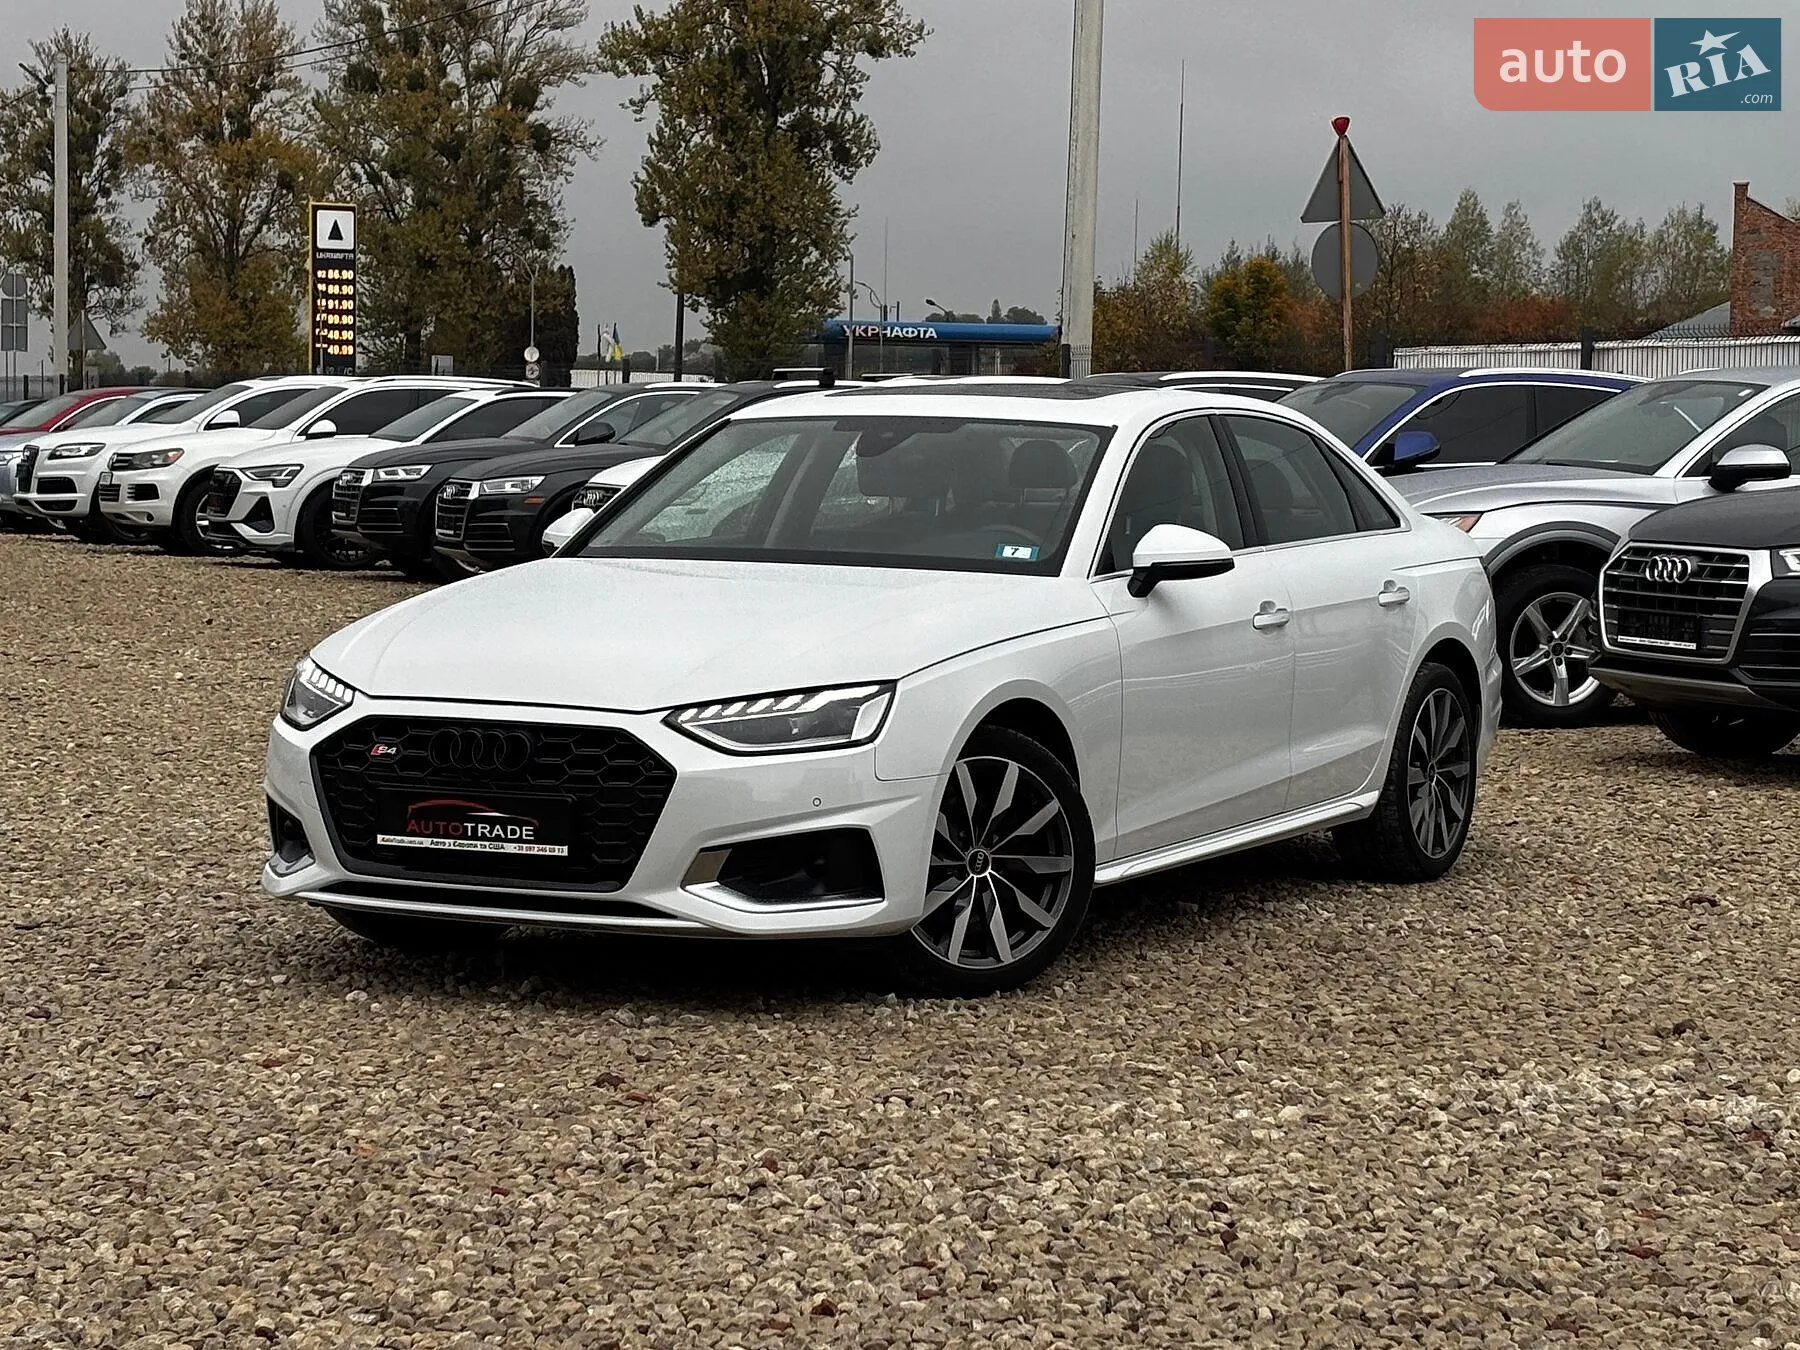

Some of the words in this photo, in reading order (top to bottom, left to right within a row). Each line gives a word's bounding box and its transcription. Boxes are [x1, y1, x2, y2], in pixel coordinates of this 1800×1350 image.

[1011, 547, 1020, 556] 7
[406, 819, 535, 841] AUTOTRADE
[488, 842, 506, 850] США
